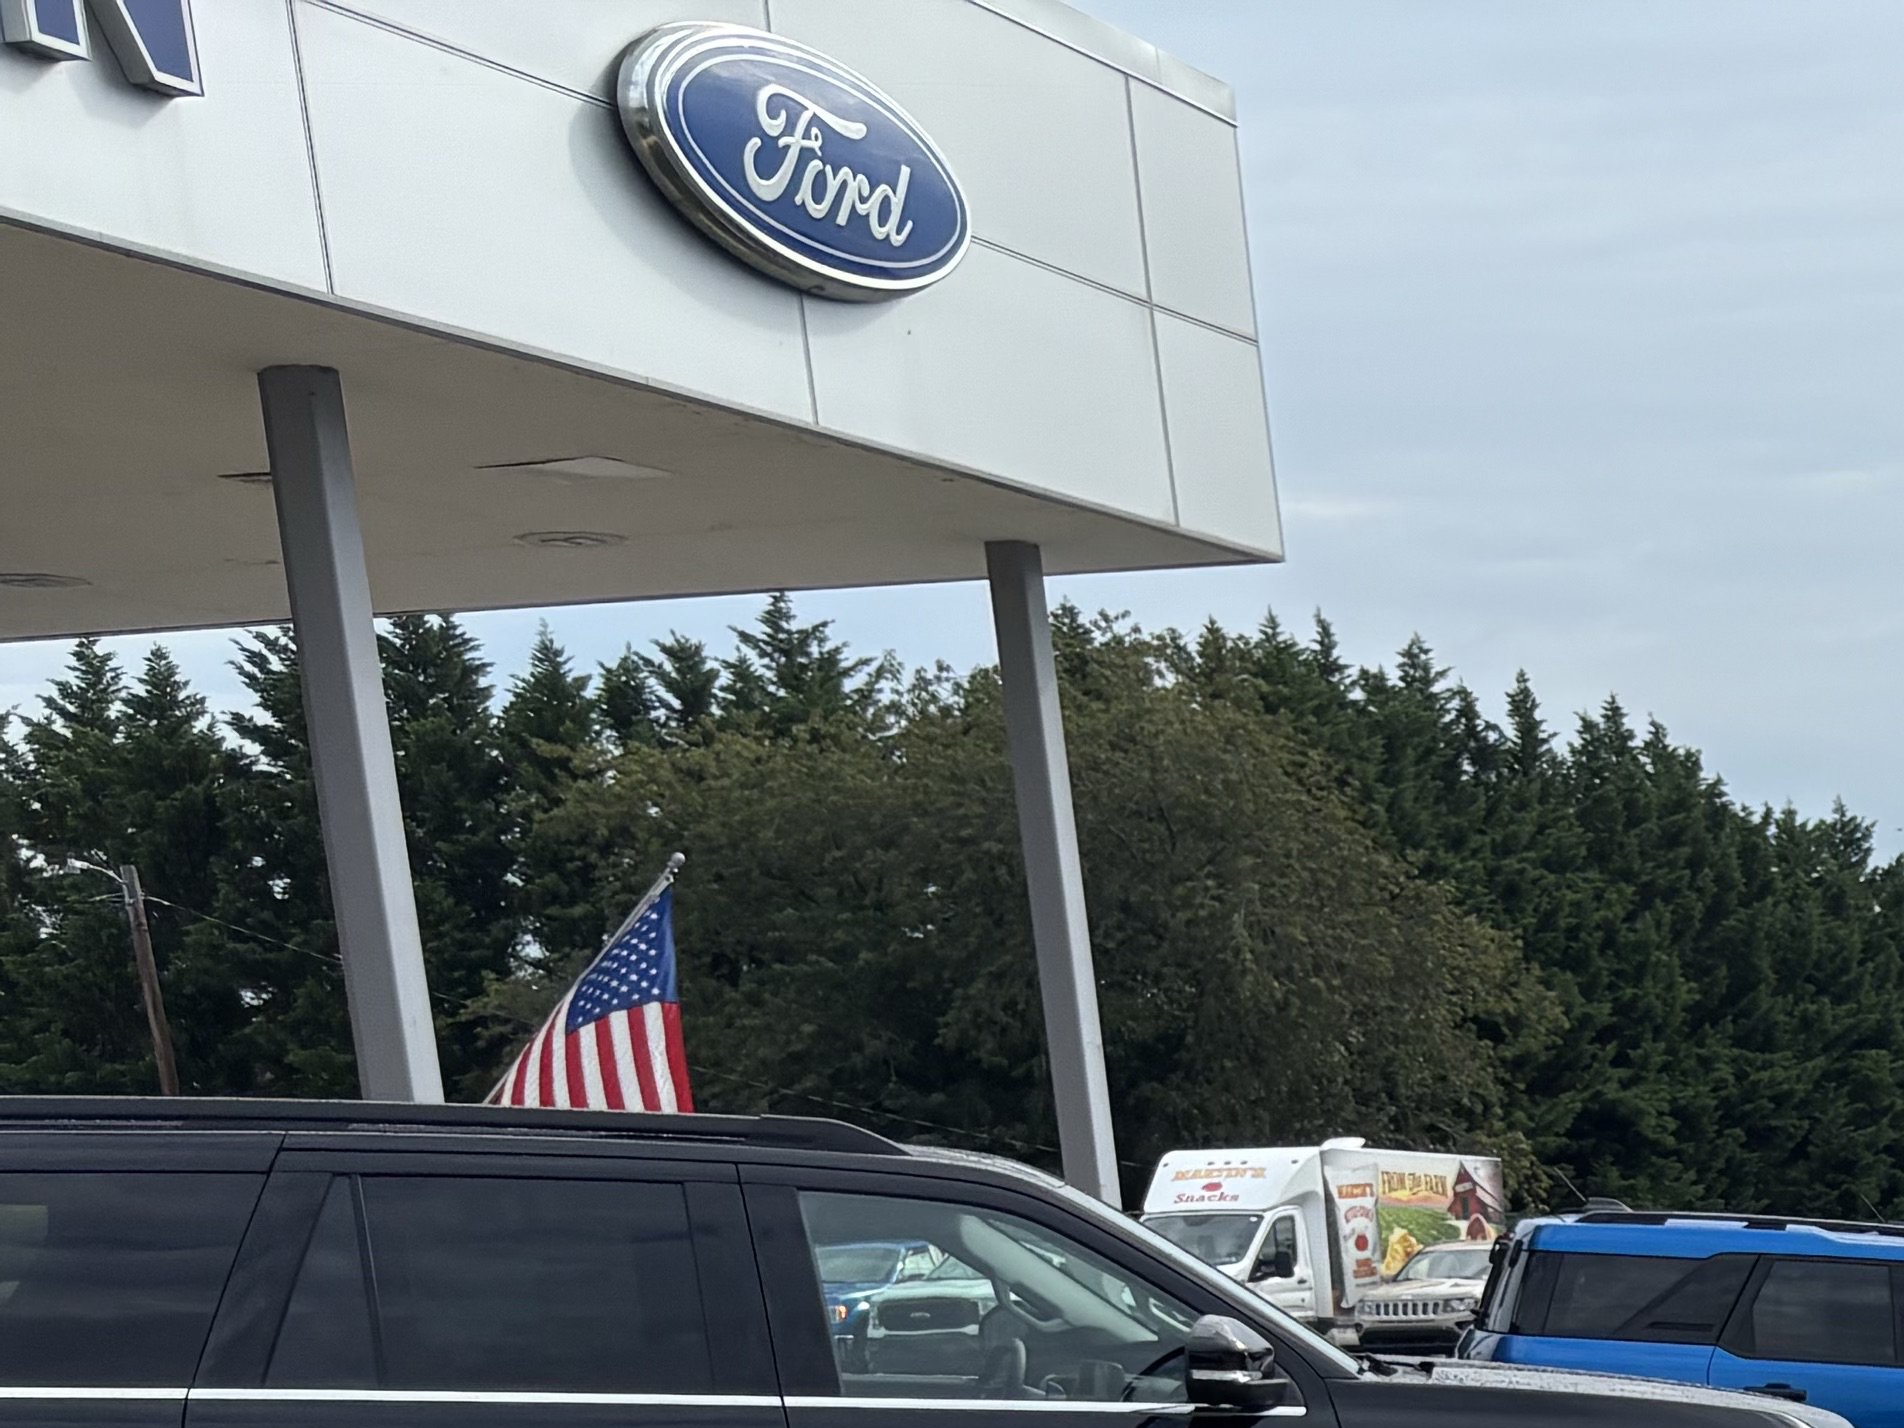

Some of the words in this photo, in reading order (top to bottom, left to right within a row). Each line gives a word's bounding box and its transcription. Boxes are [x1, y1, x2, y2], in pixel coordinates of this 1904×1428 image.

[744, 83, 913, 247] Ford
[1174, 1191, 1240, 1204] Snacks
[1381, 1171, 1406, 1194] FROM
[1423, 1174, 1448, 1199] FARM
